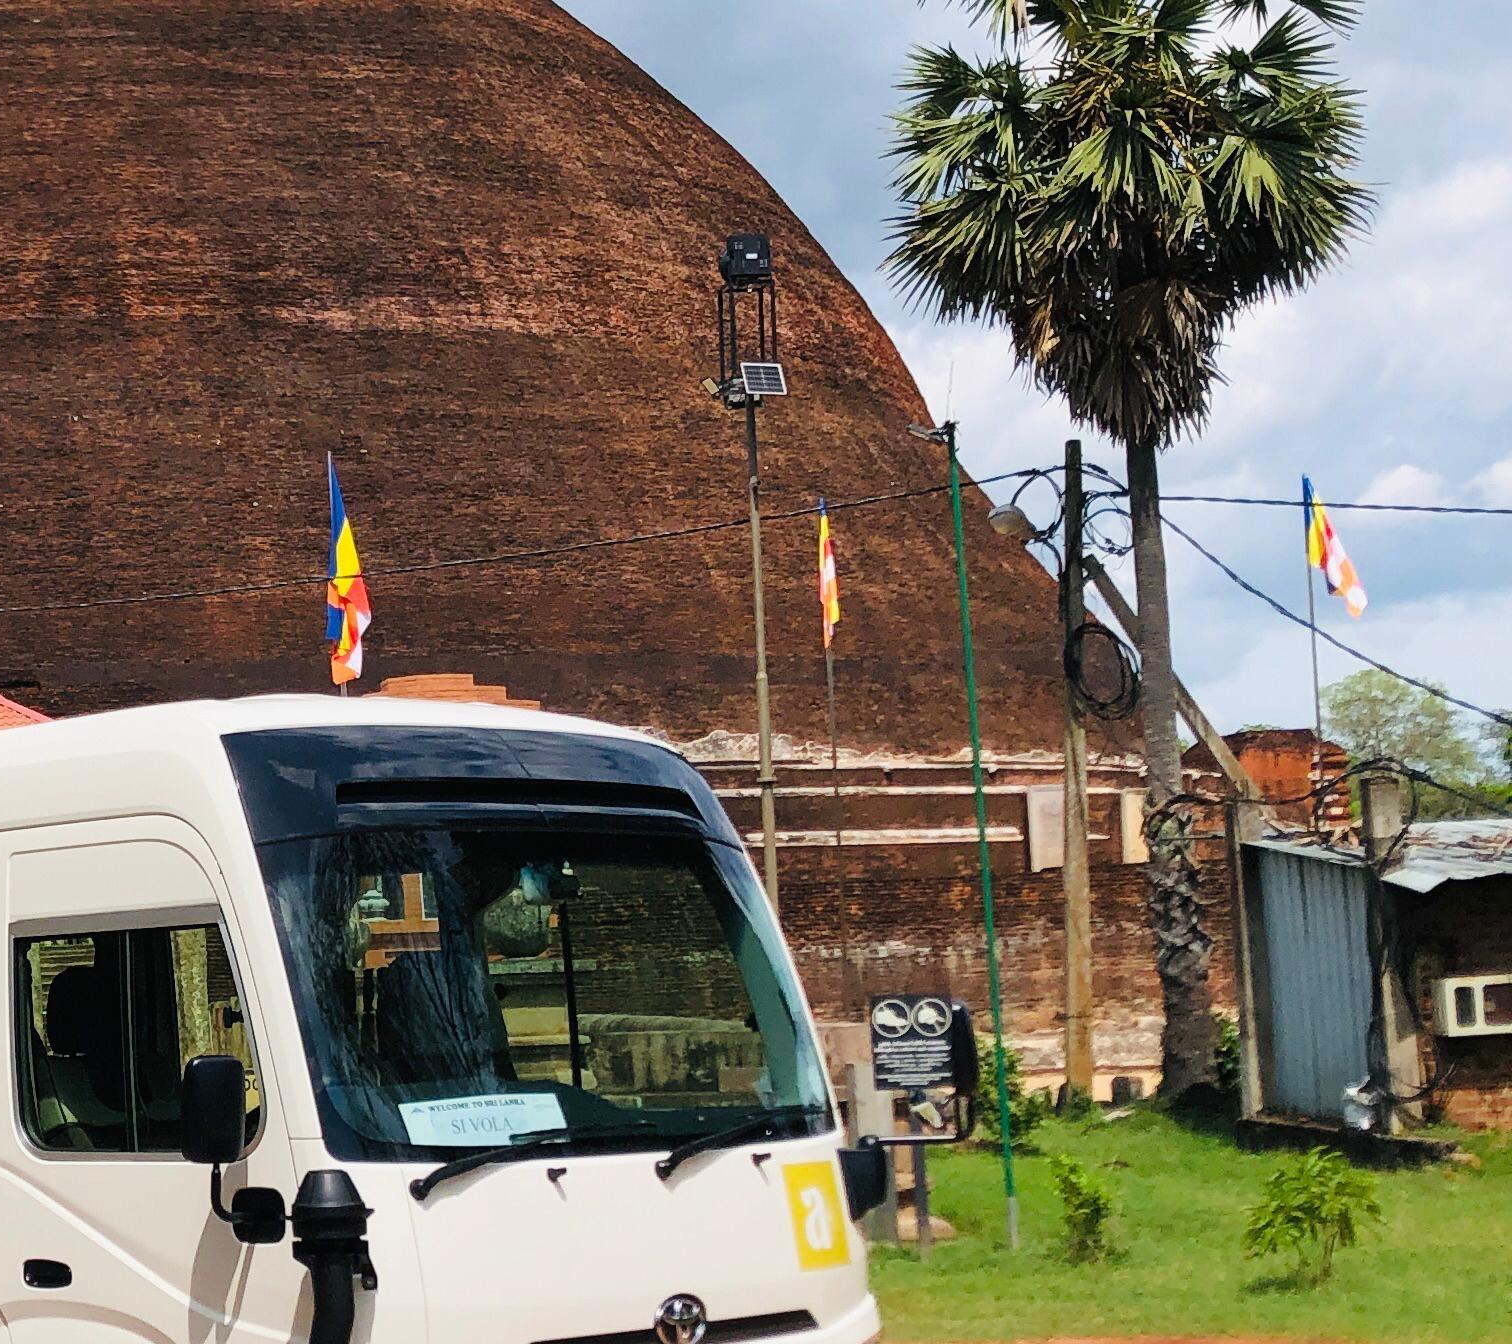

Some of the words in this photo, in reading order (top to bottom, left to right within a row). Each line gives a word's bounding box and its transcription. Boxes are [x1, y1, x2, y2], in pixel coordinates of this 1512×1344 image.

[429, 1102, 470, 1112] WELCOME
[468, 1116, 513, 1132] VOLA
[799, 1187, 833, 1251] a
